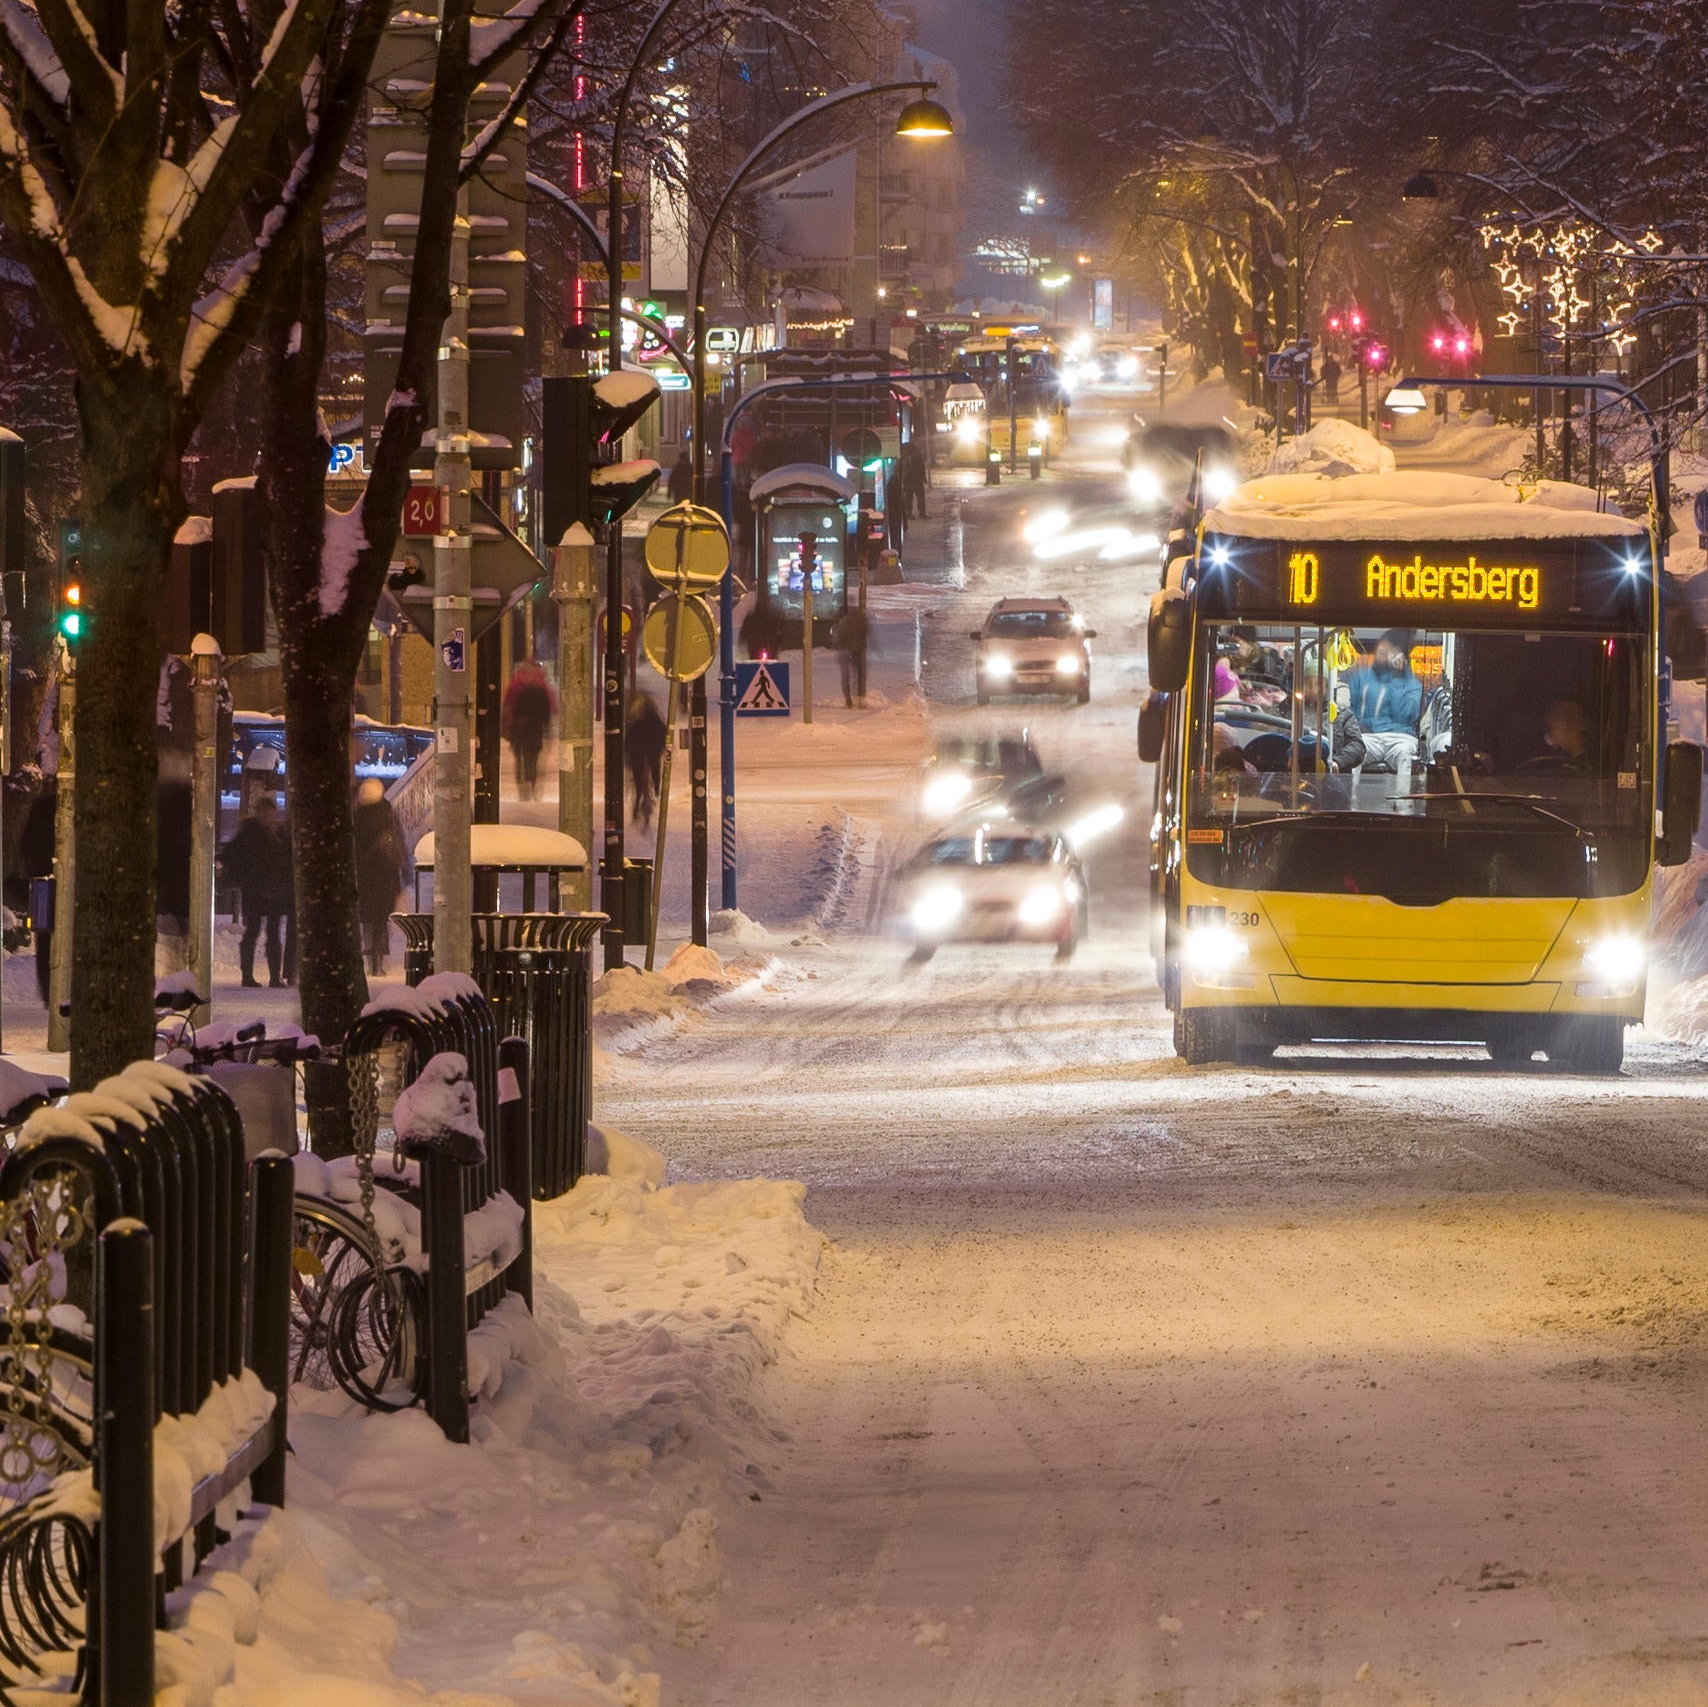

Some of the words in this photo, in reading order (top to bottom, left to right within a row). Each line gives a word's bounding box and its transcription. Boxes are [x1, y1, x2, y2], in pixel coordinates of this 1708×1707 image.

[411, 500, 434, 527] 2,0
[1289, 553, 1319, 603] 10
[1366, 555, 1539, 608] Andersberg
[1230, 912, 1260, 927] 230
